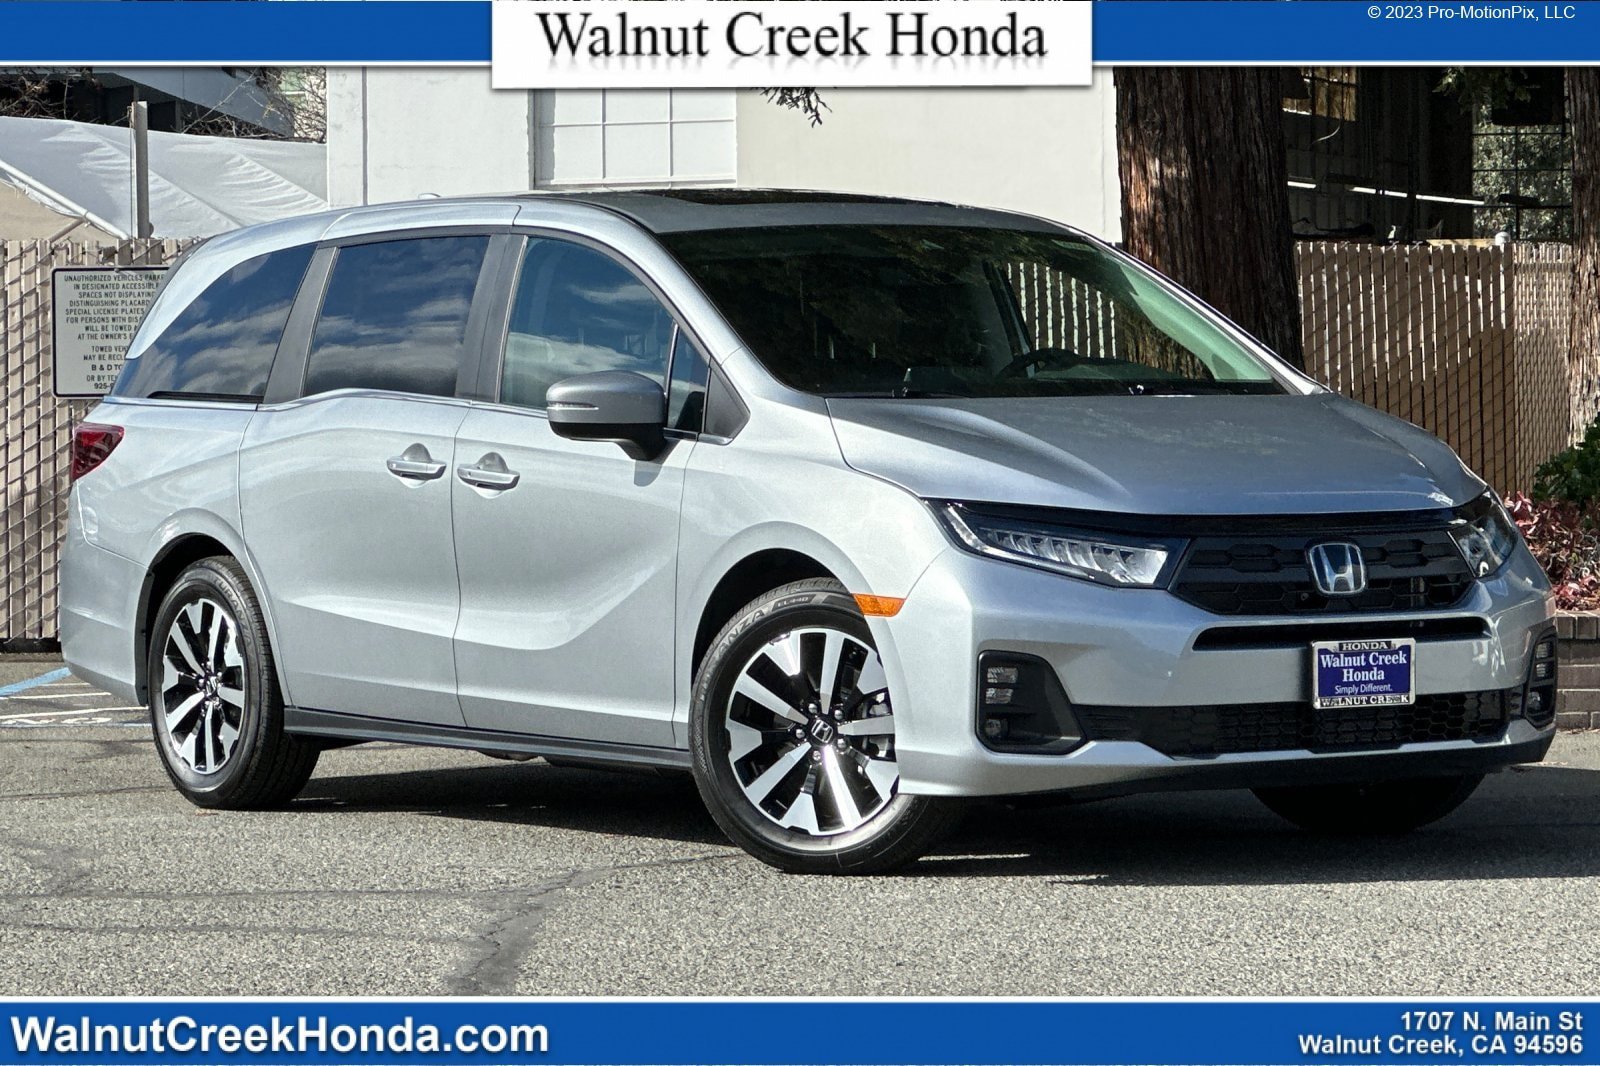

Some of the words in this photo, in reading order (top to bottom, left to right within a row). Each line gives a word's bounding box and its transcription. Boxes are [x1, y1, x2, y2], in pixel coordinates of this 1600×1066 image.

[64, 274, 112, 282] UNAUTHORIZED
[1342, 642, 1389, 651] HONDA
[1320, 654, 1366, 668] Walnut
[1368, 650, 1408, 666] Creek
[1342, 667, 1385, 682] Honda
[1334, 684, 1359, 696] Simply
[1360, 684, 1393, 693] Different.
